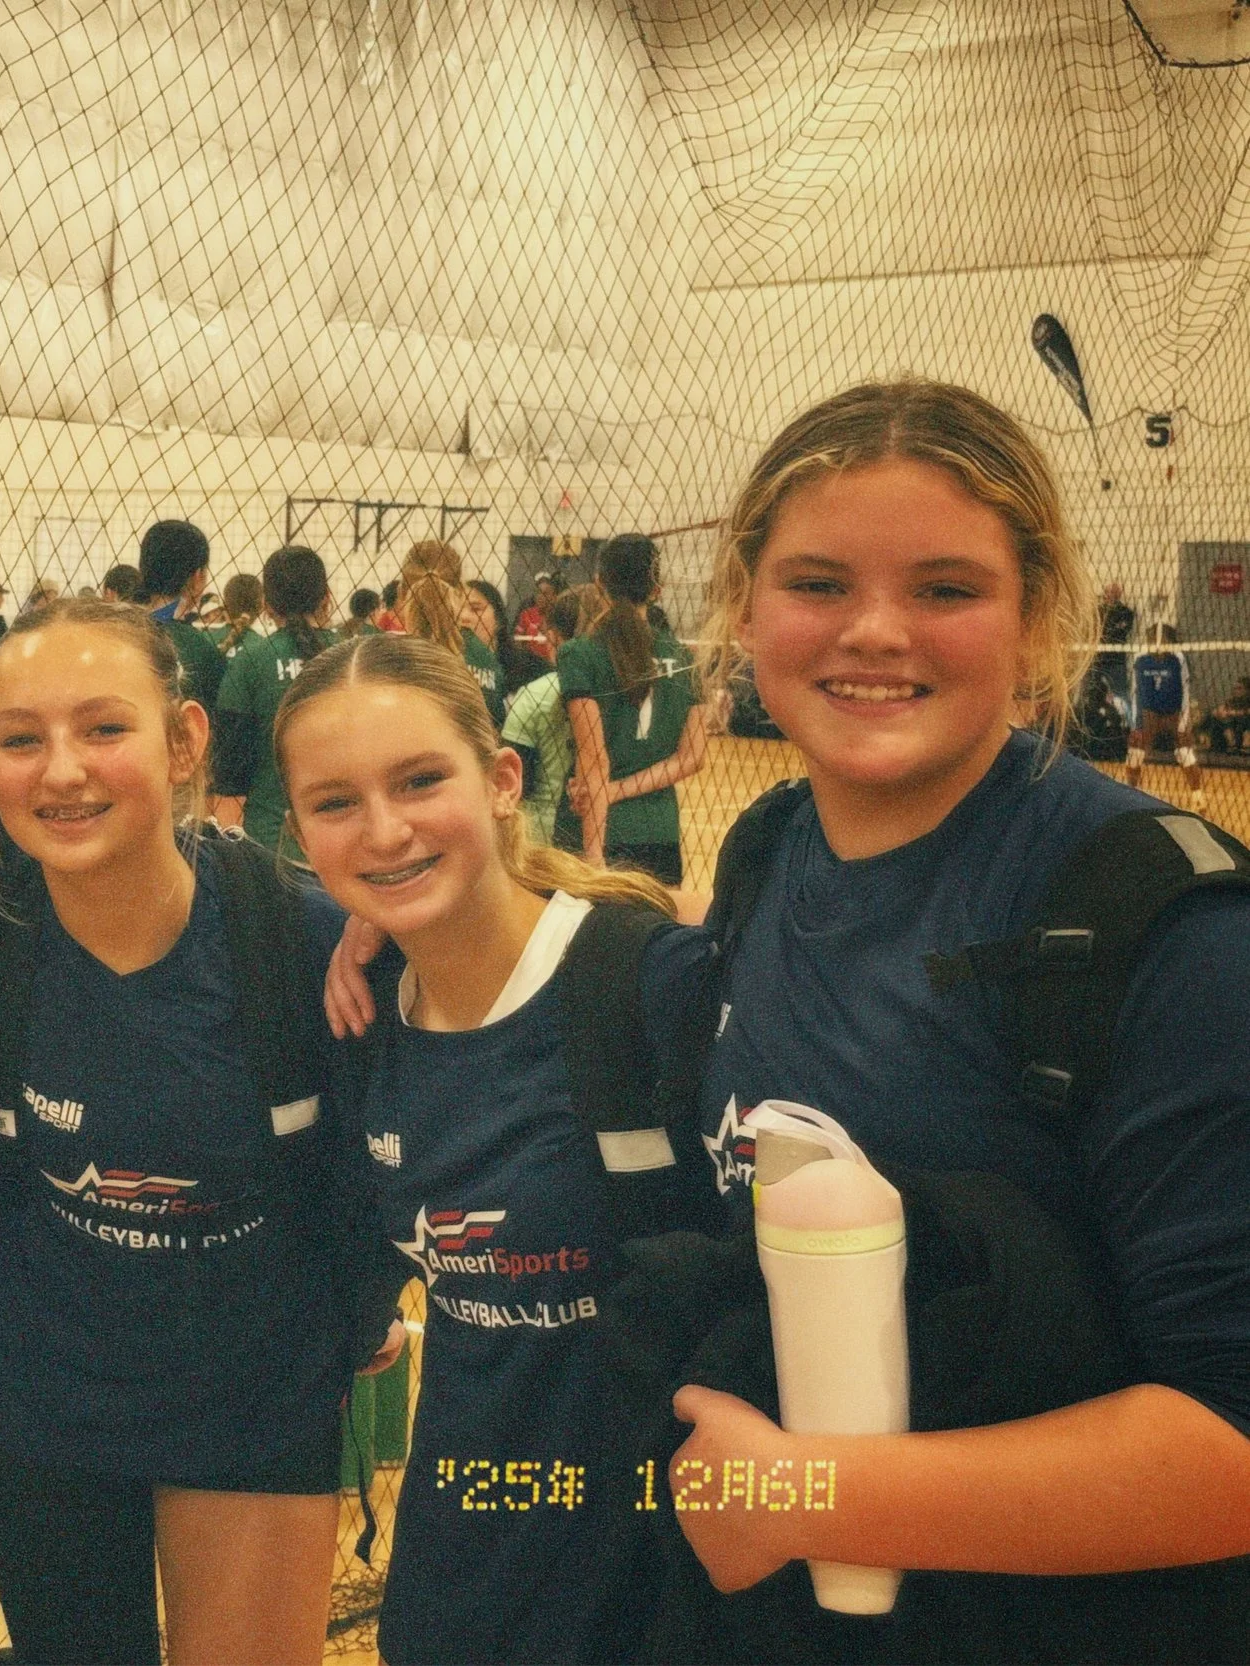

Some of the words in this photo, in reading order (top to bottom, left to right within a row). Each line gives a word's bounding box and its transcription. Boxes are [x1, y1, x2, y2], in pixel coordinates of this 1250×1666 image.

[1145, 415, 1172, 448] 5
[23, 1083, 85, 1127] apelli
[38, 1112, 79, 1134] SPORT
[427, 1246, 590, 1280] AmeriSports
